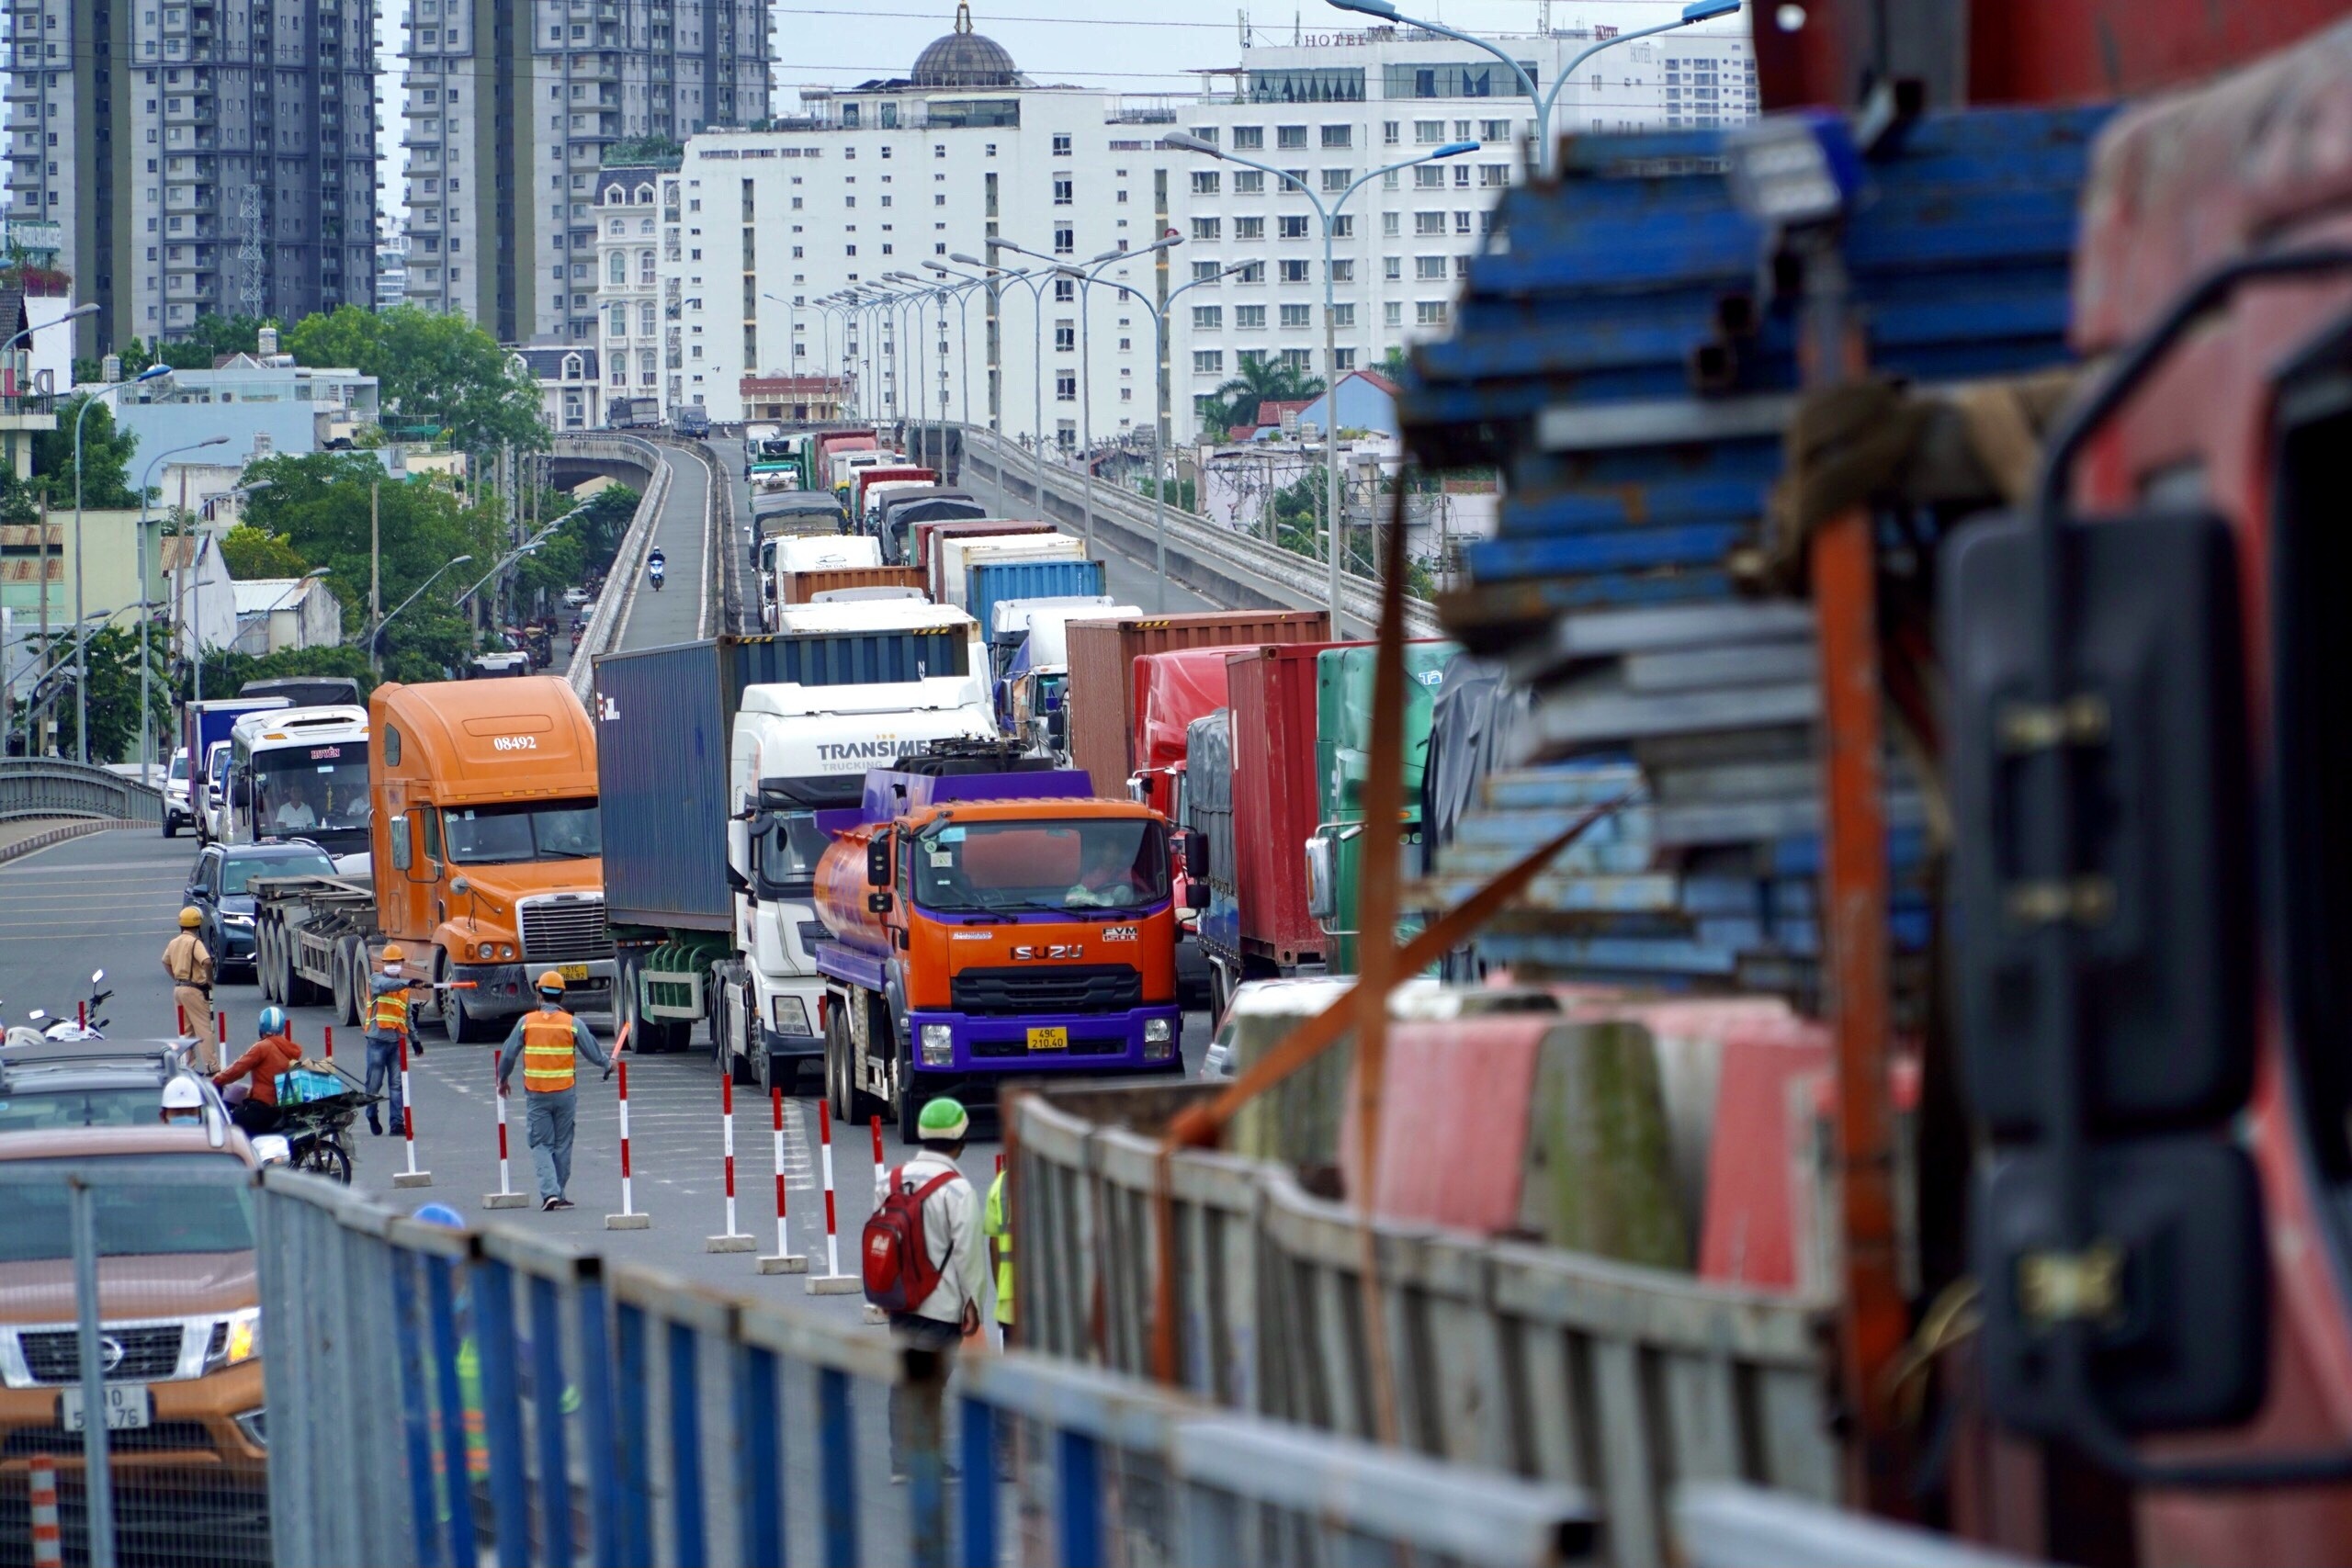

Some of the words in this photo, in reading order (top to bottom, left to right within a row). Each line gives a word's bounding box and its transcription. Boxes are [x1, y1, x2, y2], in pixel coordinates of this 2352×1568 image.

[1306, 34, 1366, 47] HOTEL
[1630, 46, 1652, 63] HOTEL
[493, 736, 537, 750] 08492
[817, 739, 932, 761] TRANSIME
[821, 761, 882, 772] TRUCKING
[1102, 927, 1137, 935] FVM
[1010, 944, 1083, 961] ISUZU
[1039, 1029, 1056, 1038] 49C
[1032, 1038, 1064, 1048] 210.40
